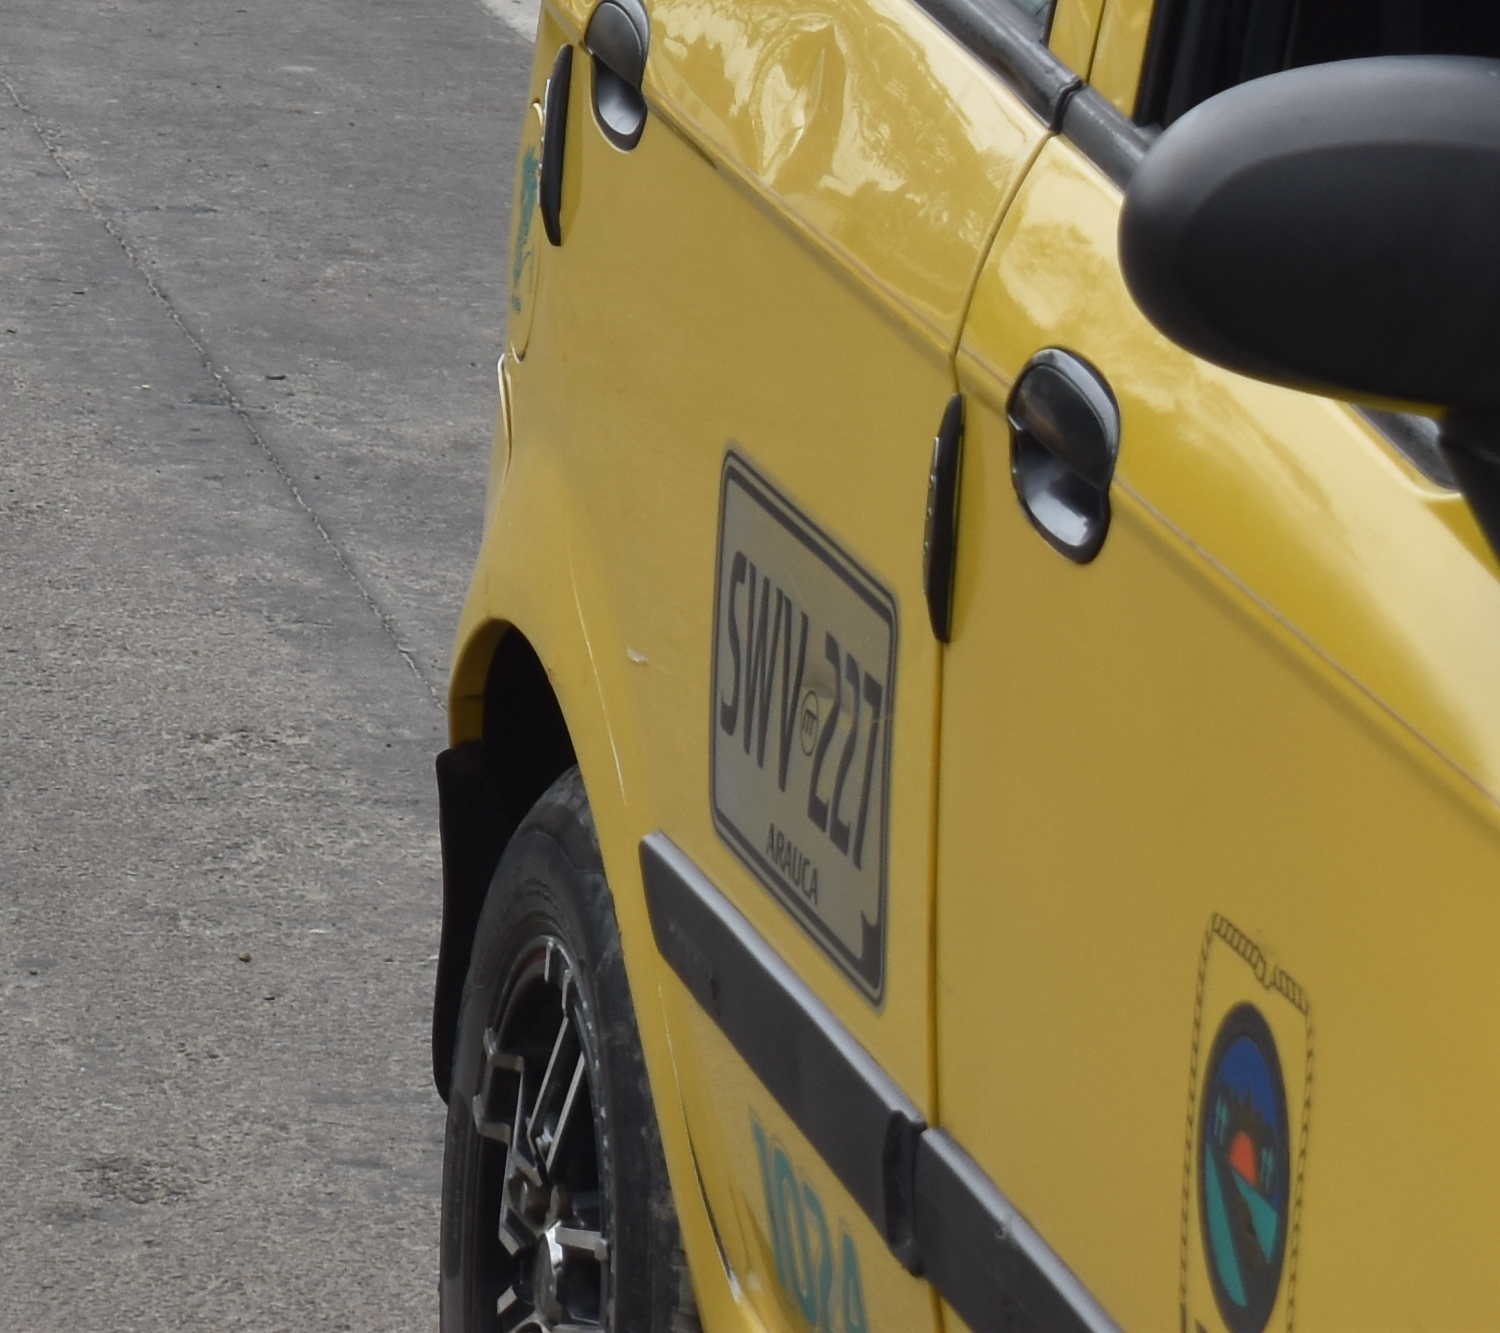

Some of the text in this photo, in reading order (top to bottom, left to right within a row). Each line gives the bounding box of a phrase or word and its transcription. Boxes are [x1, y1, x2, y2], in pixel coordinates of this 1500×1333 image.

[719, 549, 883, 871] SWV 227
[765, 822, 819, 907] ARAUCA
